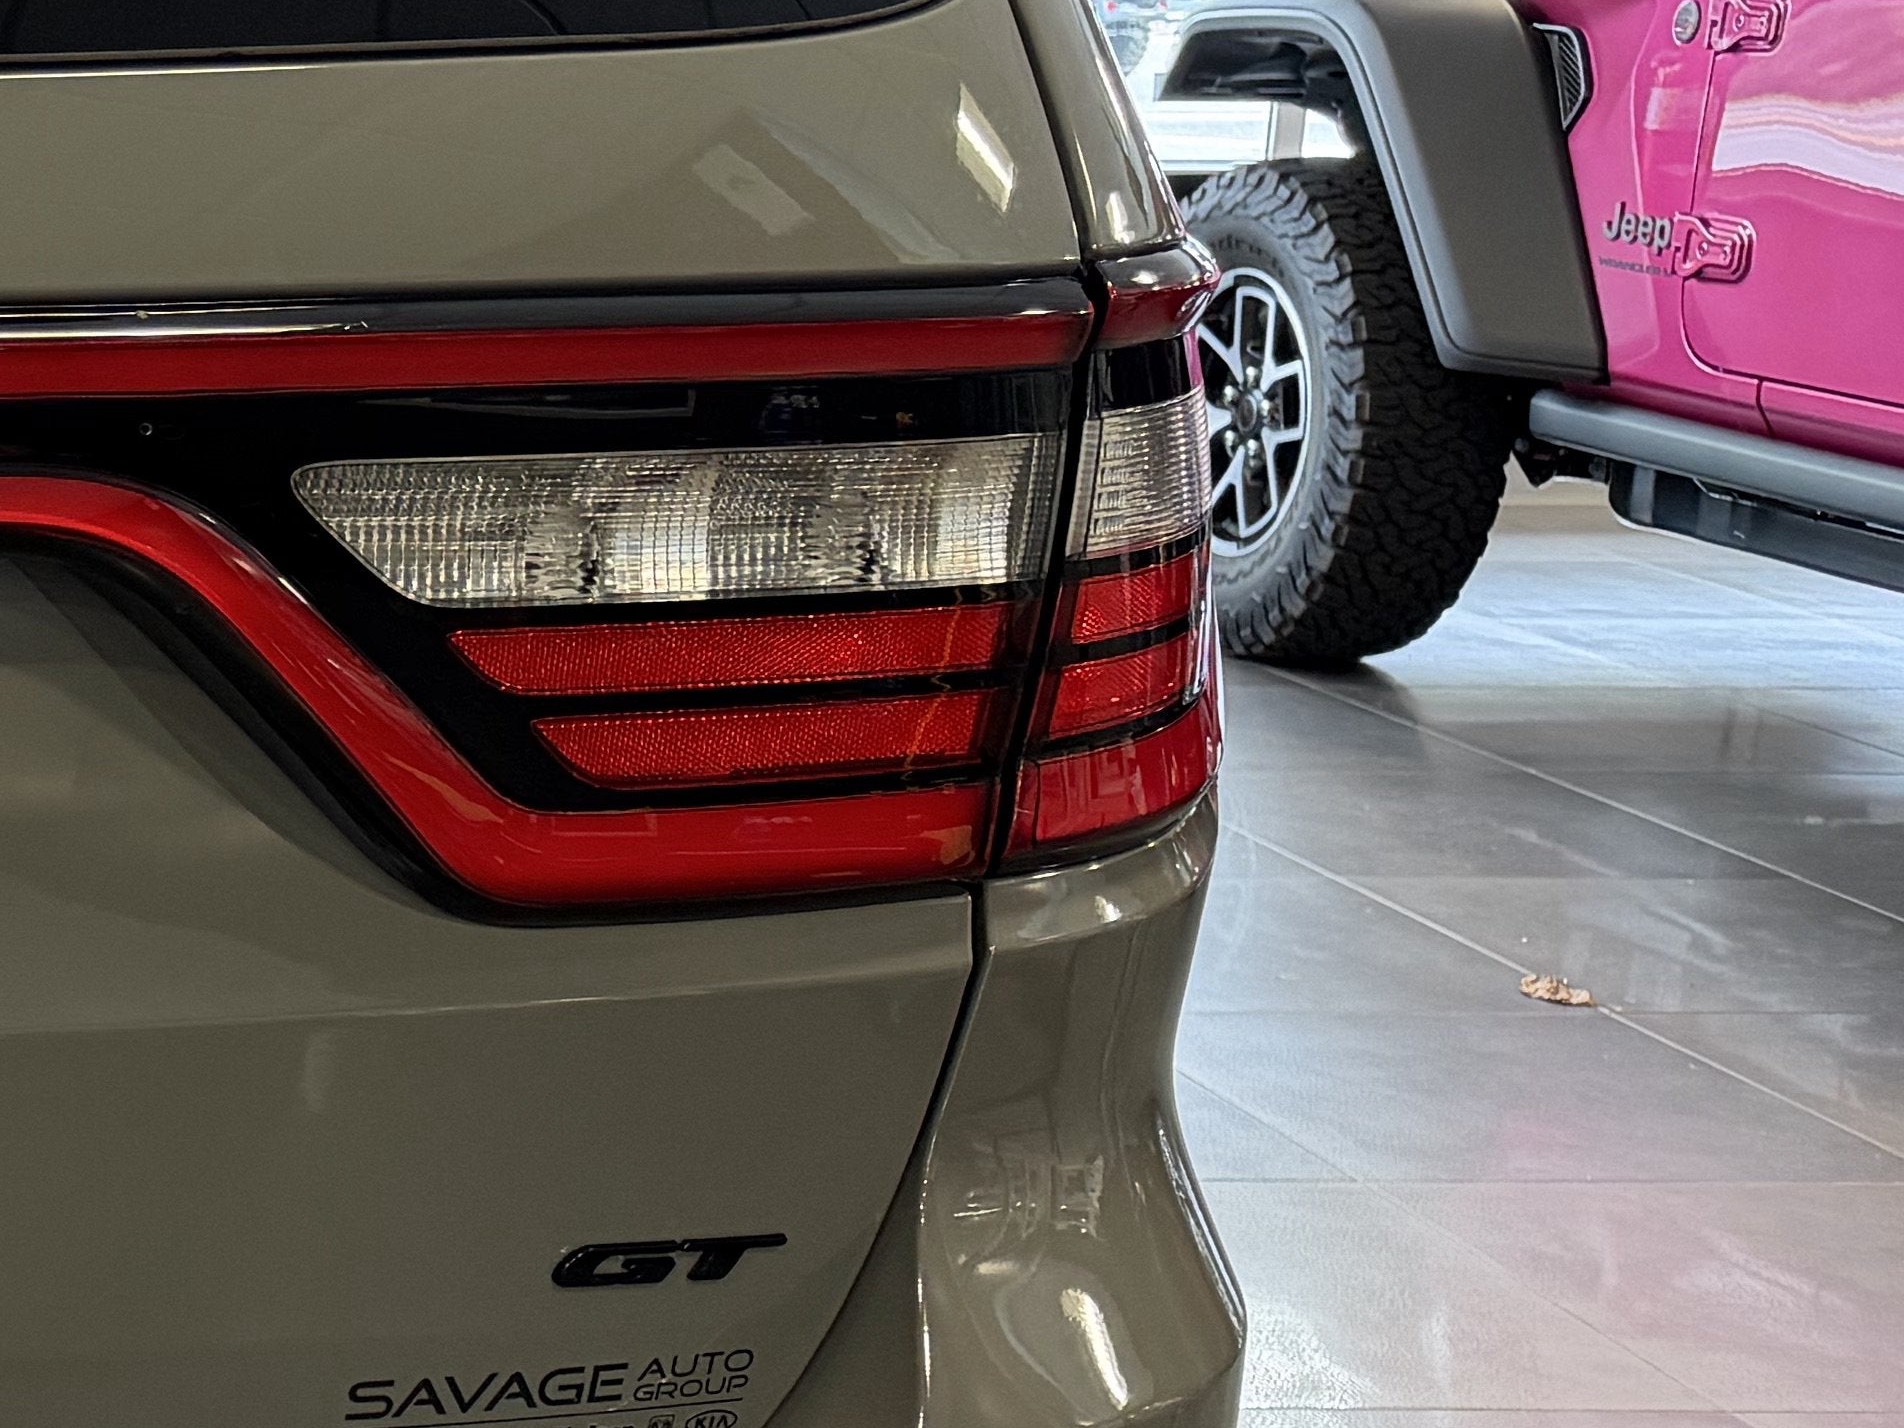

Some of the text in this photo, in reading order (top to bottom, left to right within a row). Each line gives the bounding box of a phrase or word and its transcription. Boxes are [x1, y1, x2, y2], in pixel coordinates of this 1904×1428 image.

[1602, 202, 1673, 257] Jeep
[551, 1232, 789, 1288] GT
[344, 1362, 629, 1421] SAVAGE
[633, 1374, 749, 1401] GROUP
[637, 1348, 754, 1382] AUTO
